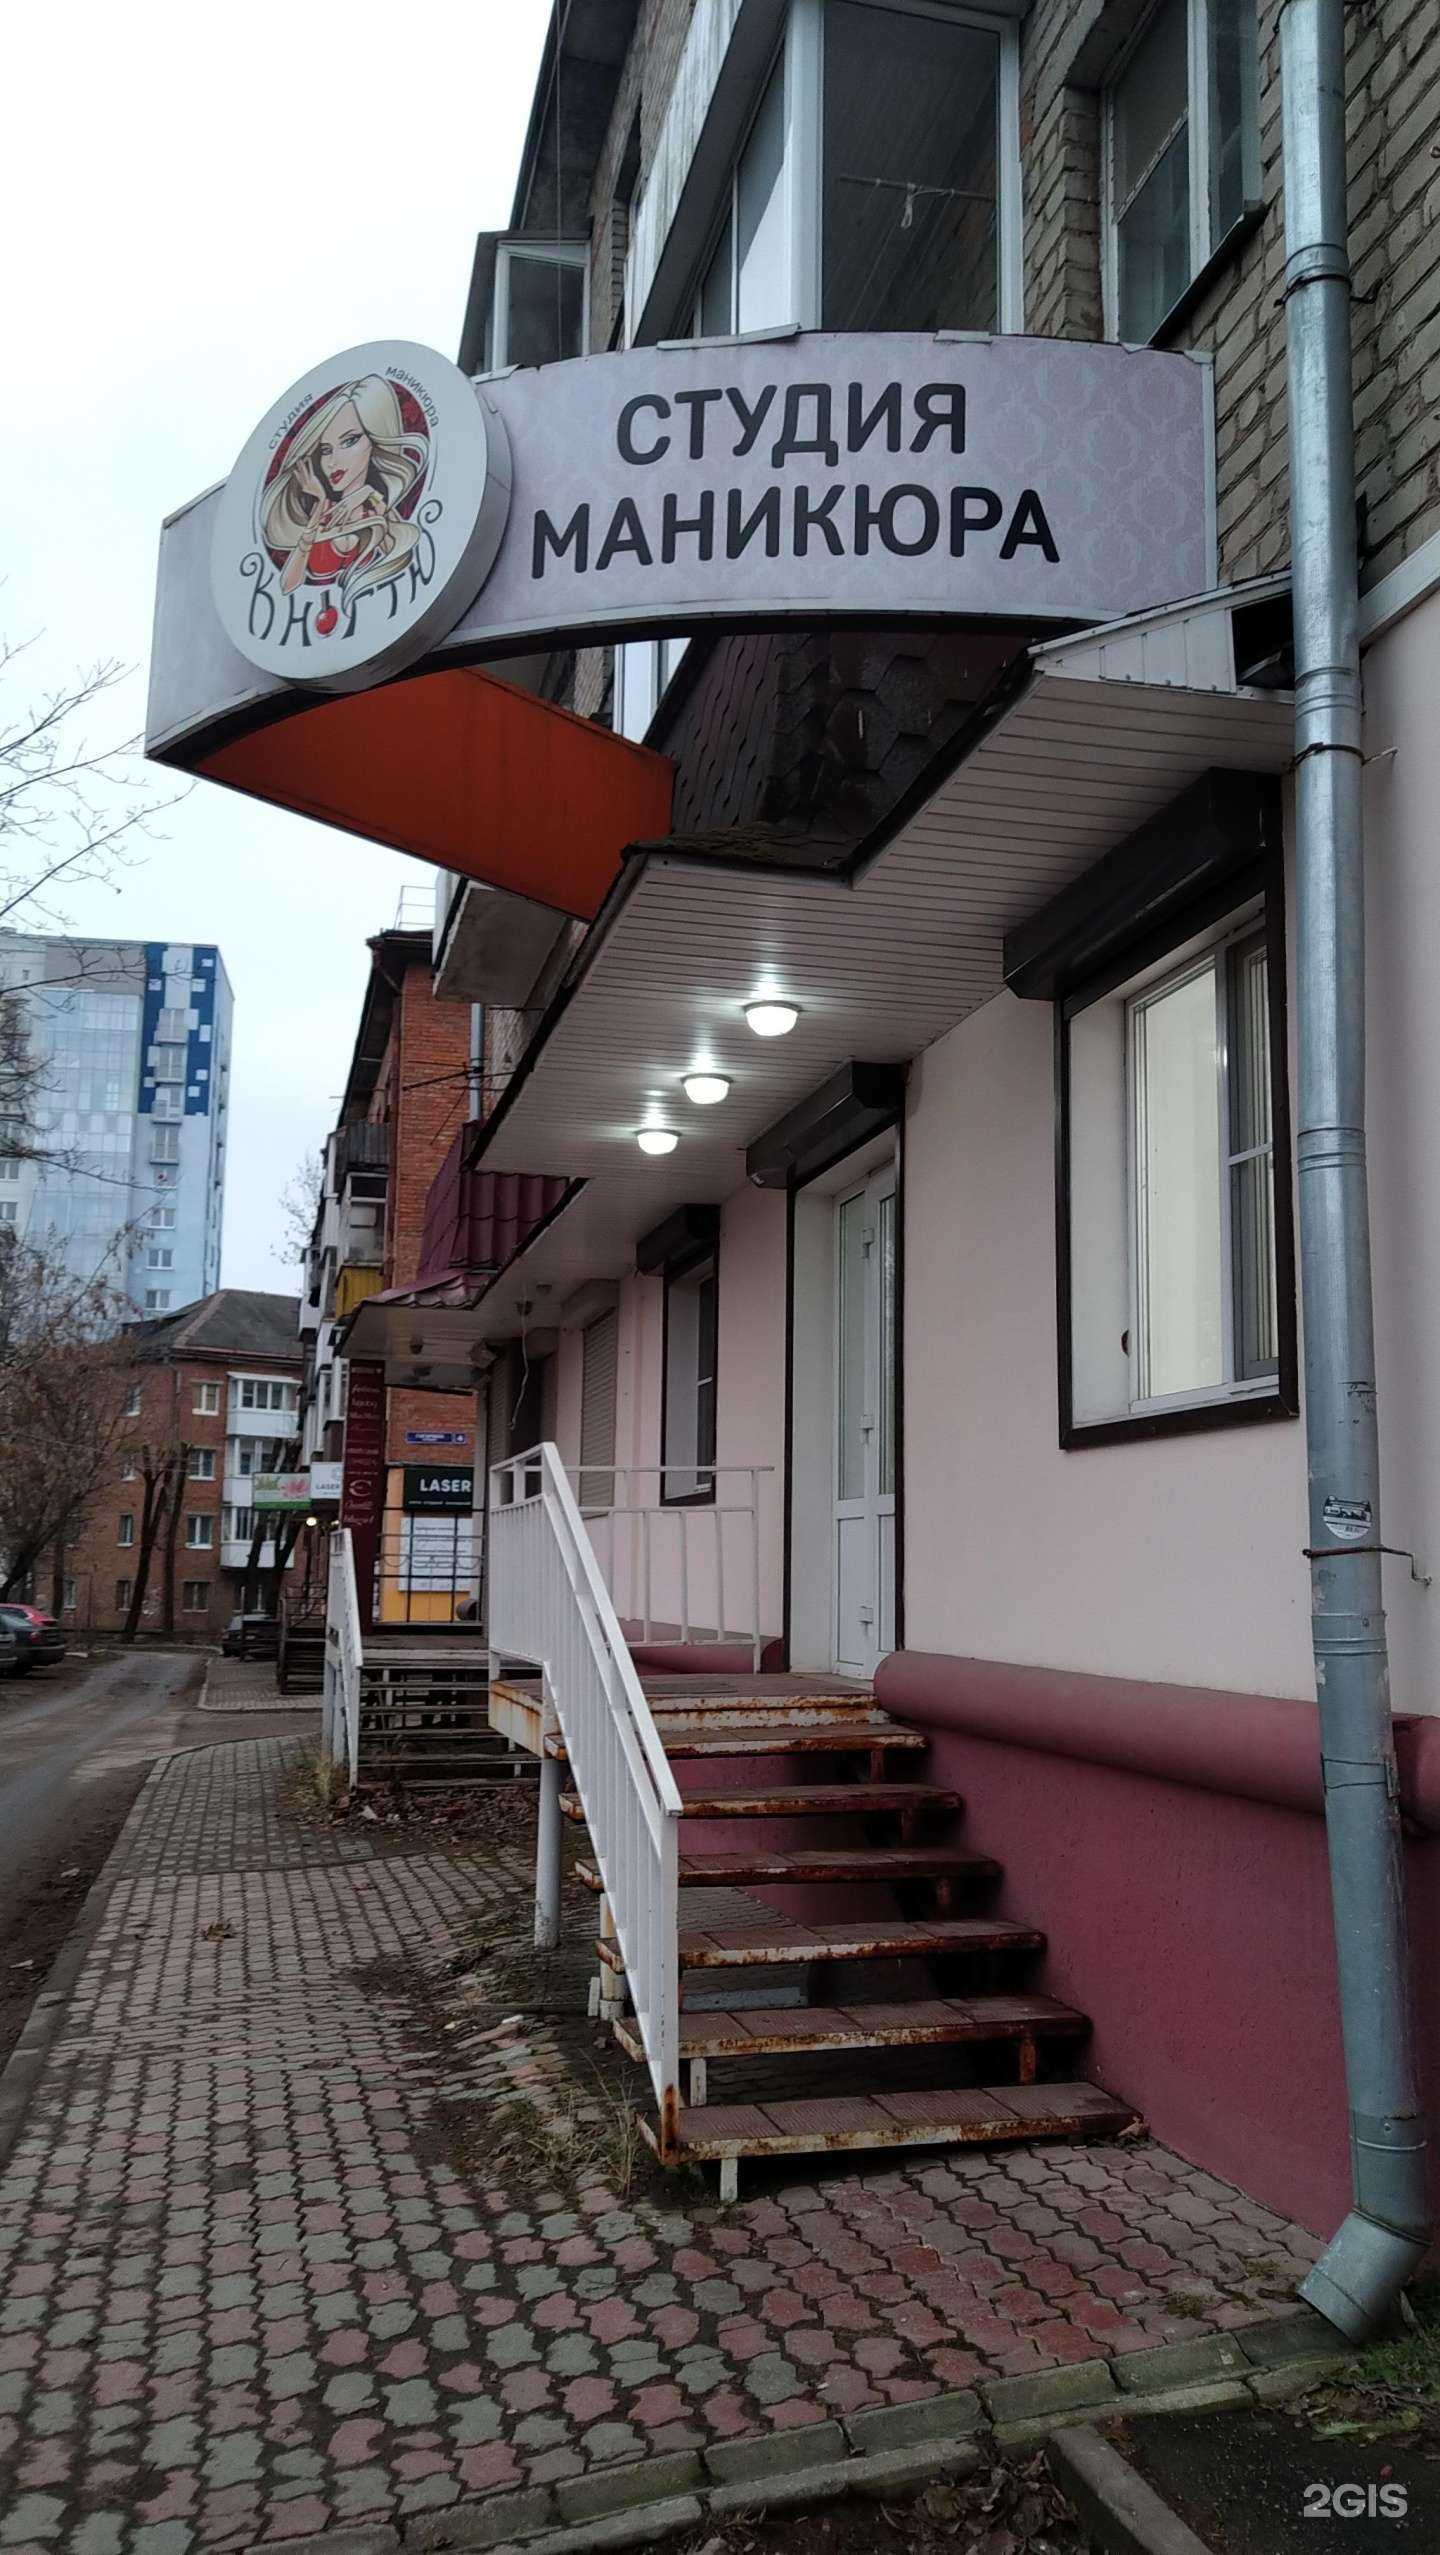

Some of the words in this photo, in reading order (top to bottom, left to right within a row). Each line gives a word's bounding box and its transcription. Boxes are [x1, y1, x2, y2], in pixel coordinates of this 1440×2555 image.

[267, 393, 314, 451] студия
[616, 382, 966, 469] СТУДИЯ
[531, 484, 1061, 579] МАНИКЮРА
[420, 1478, 472, 1493] LASER
